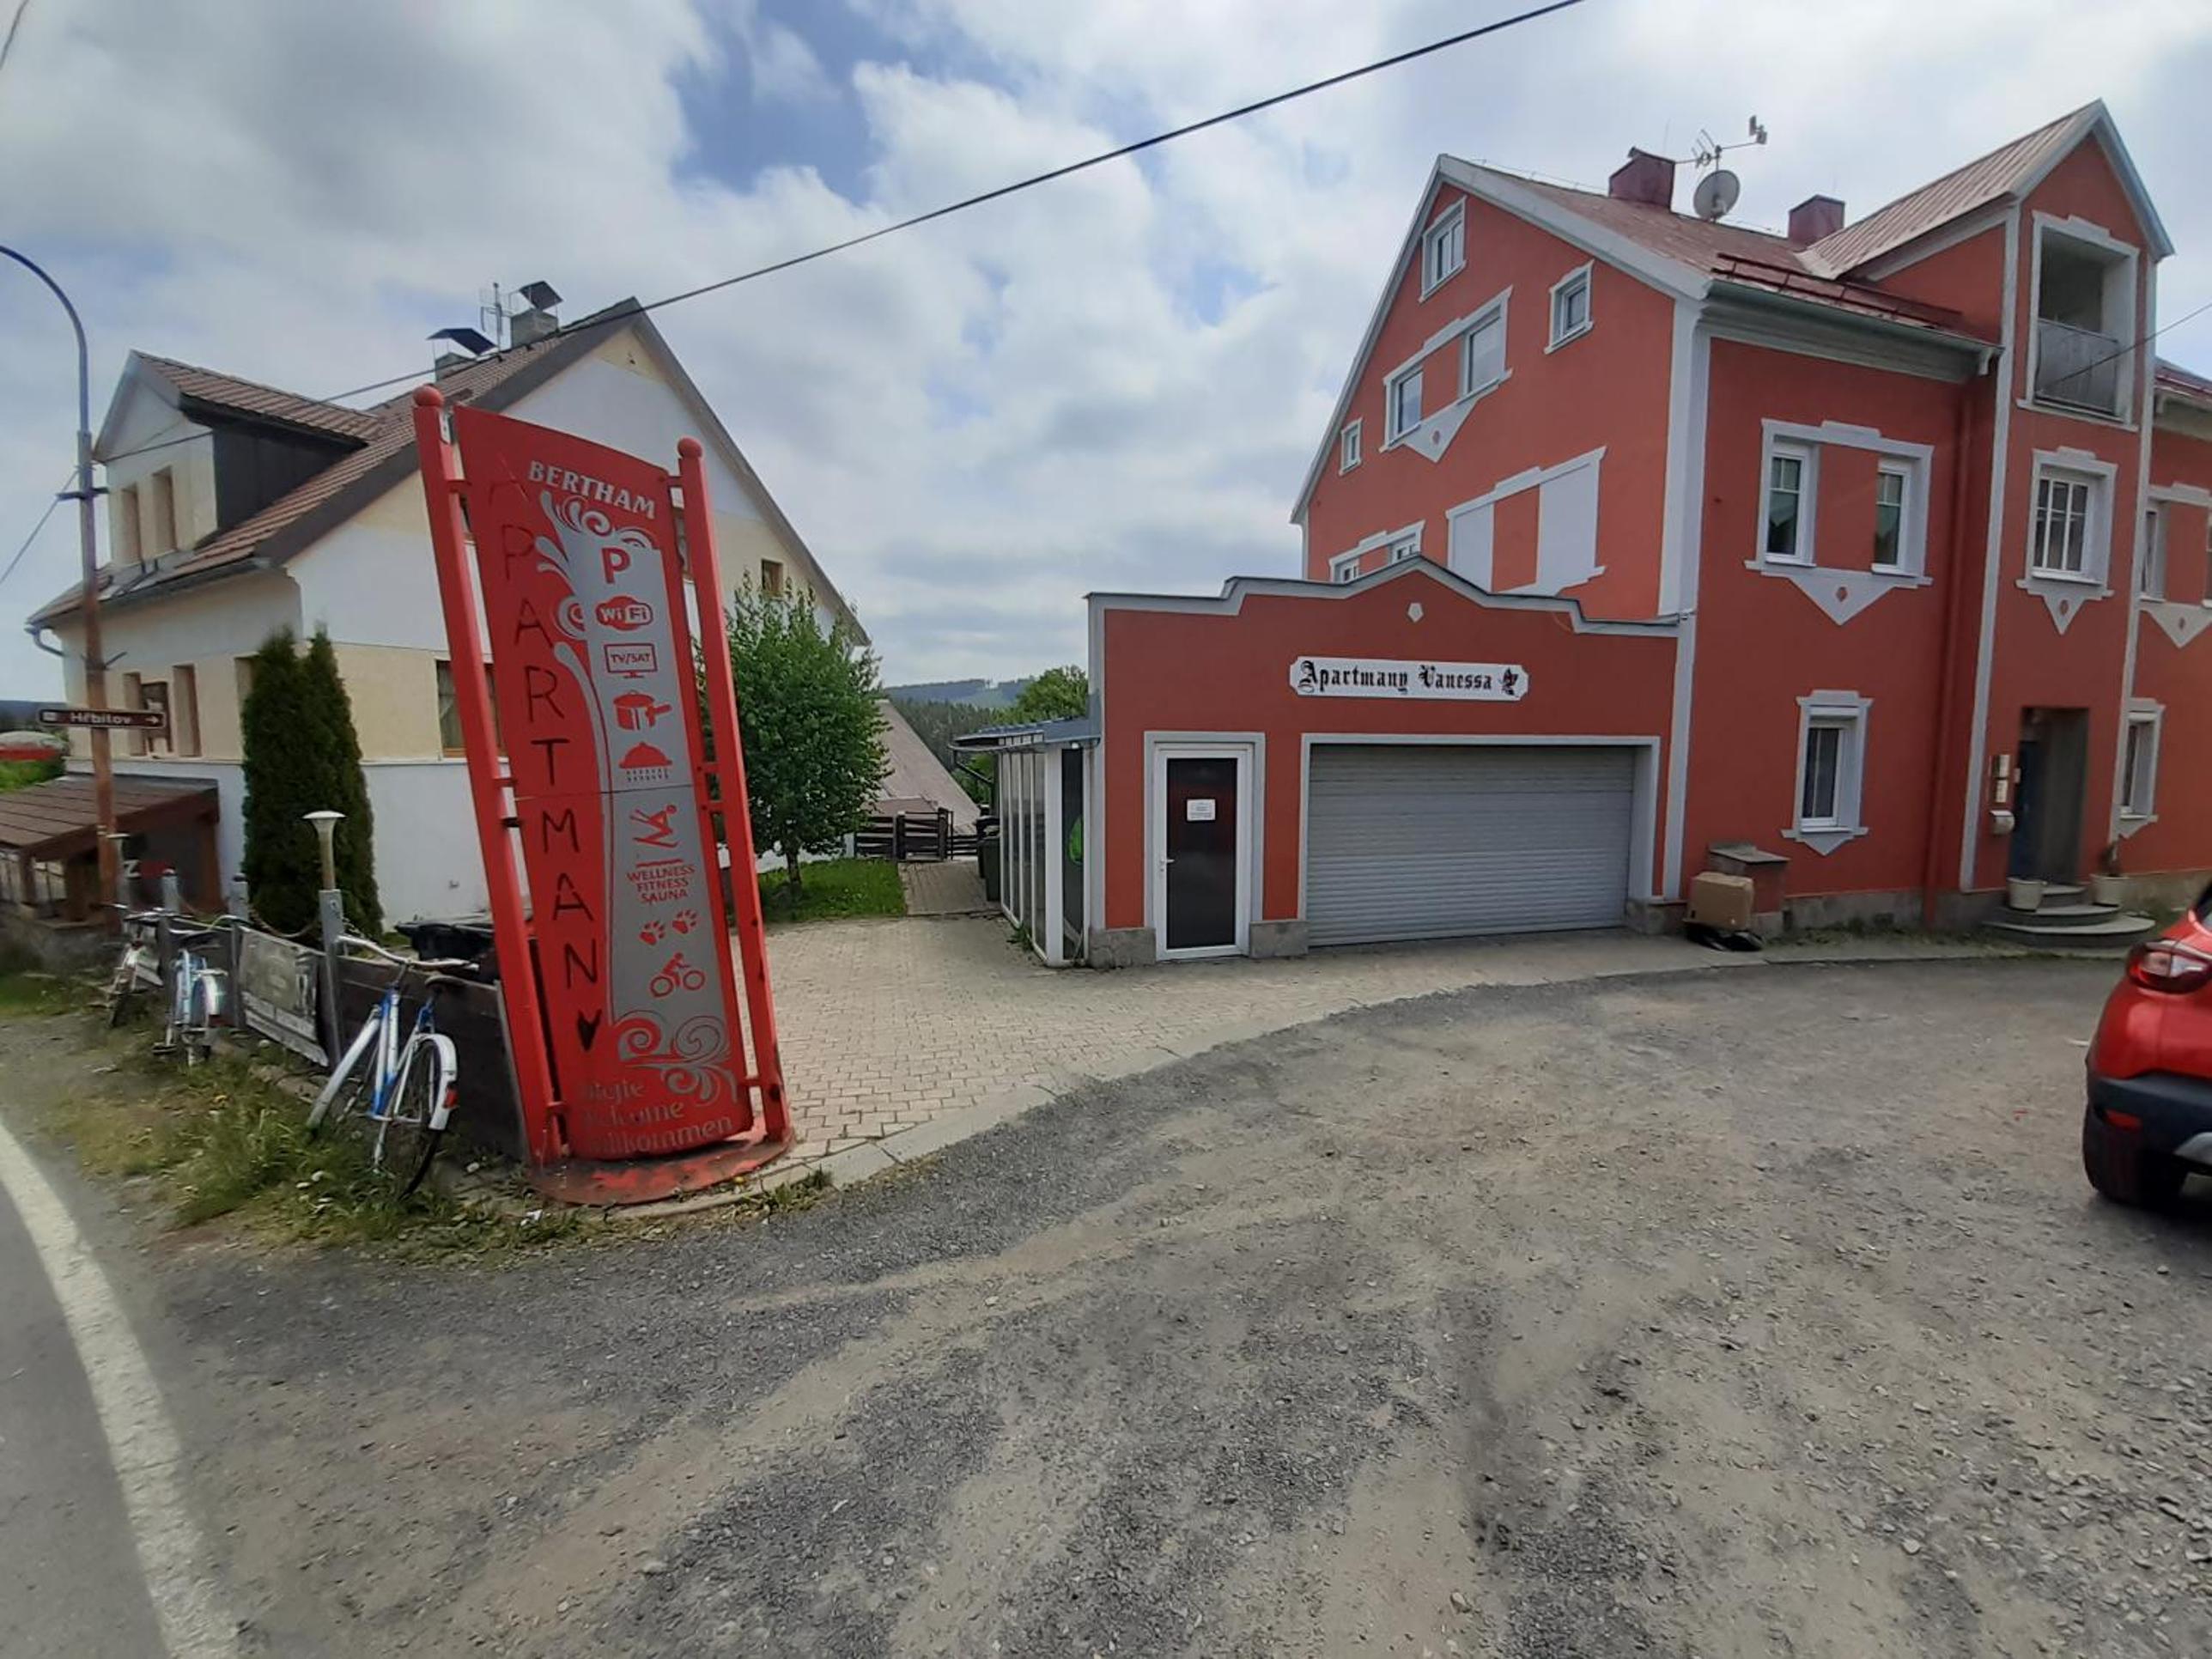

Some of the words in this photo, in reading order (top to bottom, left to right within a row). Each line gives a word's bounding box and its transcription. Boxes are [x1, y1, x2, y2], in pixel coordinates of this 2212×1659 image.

[528, 459, 656, 520] BERTHAM
[601, 546, 630, 585] P
[611, 653, 651, 665] TV/SAT
[1297, 660, 1408, 696] Apartmany
[1419, 665, 1493, 690] Vanessa
[625, 865, 696, 882] WELLNESS
[636, 878, 689, 892] FITNESS
[641, 889, 689, 905] SAUNA
